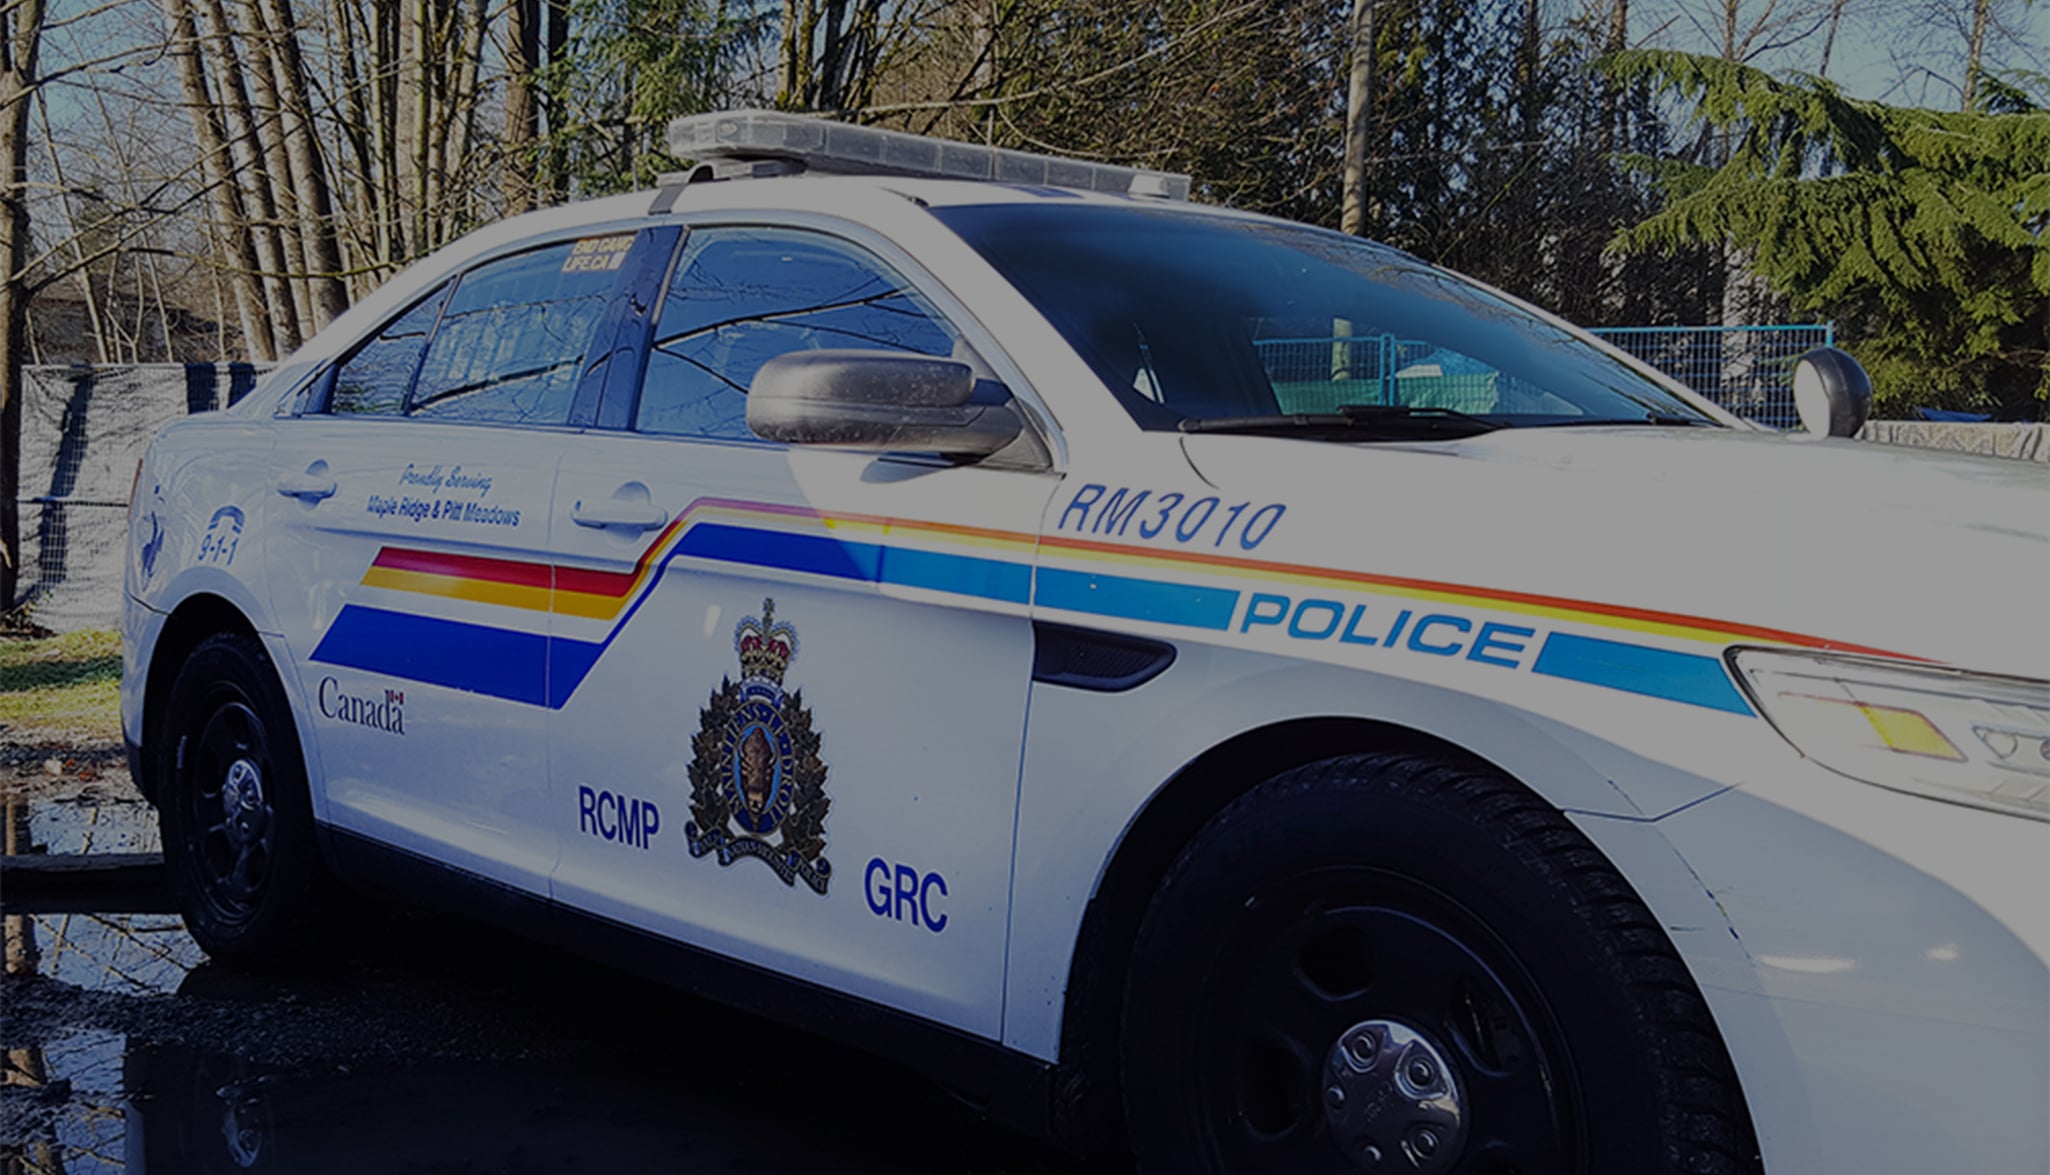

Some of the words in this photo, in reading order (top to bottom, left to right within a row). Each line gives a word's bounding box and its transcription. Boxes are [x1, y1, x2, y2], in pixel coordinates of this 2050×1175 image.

[367, 495, 398, 518] Maple
[399, 497, 431, 522] Ridge
[431, 500, 441, 519] &
[442, 500, 463, 521] Pitt
[463, 502, 521, 527] Meadows
[445, 465, 493, 498] Serving
[1058, 484, 1287, 550] RM3010
[198, 533, 240, 566] 9-1-1
[1240, 592, 1536, 669] POLICE
[319, 675, 405, 736] Canada
[579, 785, 660, 850] RCMP
[865, 857, 948, 933] GRC
